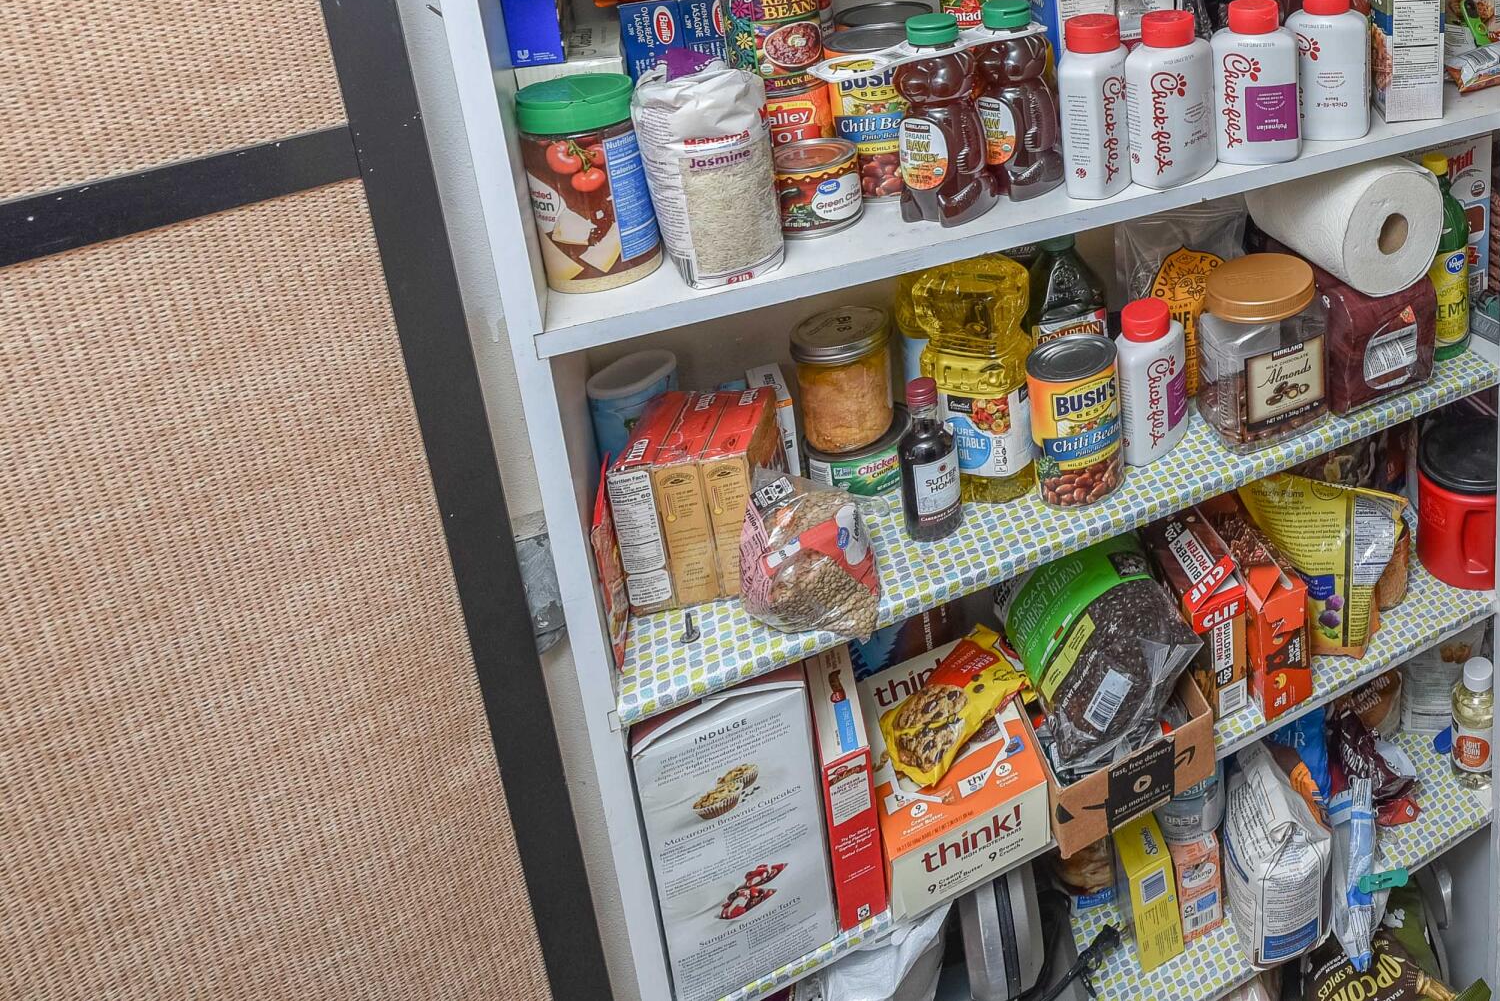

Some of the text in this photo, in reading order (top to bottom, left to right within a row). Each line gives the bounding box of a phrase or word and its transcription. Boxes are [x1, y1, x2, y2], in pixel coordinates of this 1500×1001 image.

[633, 14, 645, 44] LASAGNE
[659, 13, 671, 42] Barilla
[775, 76, 802, 88] BLACK
[841, 117, 875, 133] Chili
[904, 133, 932, 141] ORGANIC
[689, 149, 751, 170] Jasmine
[815, 197, 844, 210] Green
[1273, 343, 1304, 358] KIRKLAND
[1257, 364, 1313, 389] Almonds
[1056, 377, 1117, 417] BUSH'S
[1076, 404, 1107, 419] BEST
[1052, 433, 1089, 453] Chili
[857, 454, 898, 477] Chicken
[925, 468, 956, 487] SUTTER
[930, 479, 956, 493] HOME
[1184, 539, 1210, 573] PROTEIN
[1049, 560, 1084, 596] BLEND
[1190, 565, 1225, 604] CLIF
[1012, 563, 1059, 630] ORGANIC
[1201, 601, 1240, 629] CLIF
[1215, 626, 1223, 662] PROTEIN
[694, 719, 748, 745] INDULGE
[1461, 739, 1482, 748] LIGHT
[1112, 745, 1173, 778] fast, free delivery
[1114, 784, 1170, 815] top movies tv
[663, 785, 802, 846] Macaroon Brownie Cupcakes
[921, 803, 1024, 873] think!
[960, 827, 1022, 861] HIGH PROTEIN BARS
[988, 852, 997, 862] 9
[927, 863, 984, 895] 9 Peanut Butter
[938, 869, 964, 885] Creamy
[738, 908, 778, 930] Brownie
